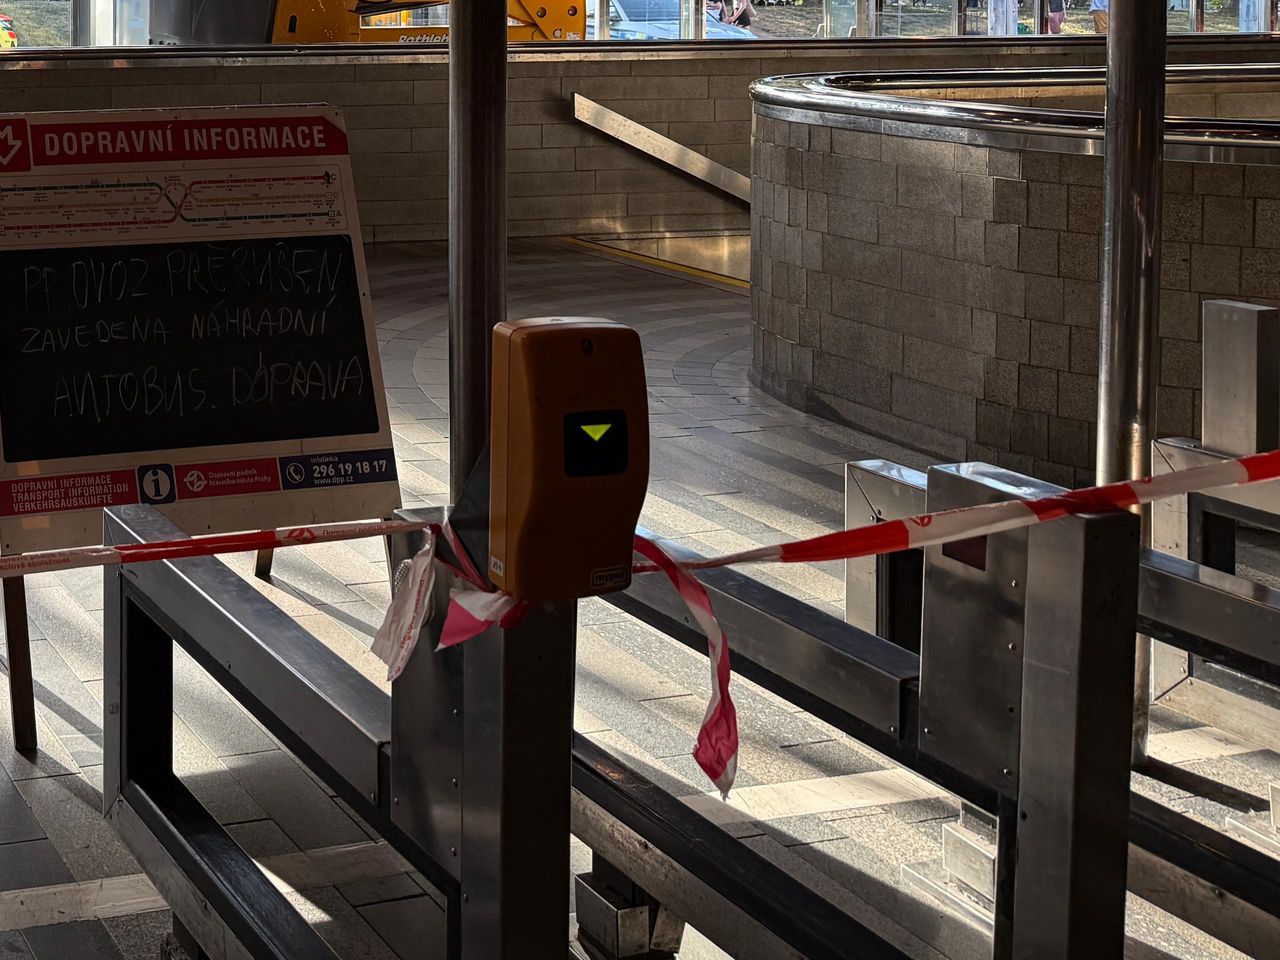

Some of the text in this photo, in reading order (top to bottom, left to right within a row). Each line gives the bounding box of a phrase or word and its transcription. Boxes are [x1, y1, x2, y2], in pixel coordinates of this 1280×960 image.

[44, 125, 328, 157] DOPRAVNÍ INFORMACE
[21, 294, 336, 353] ZAVEDENA NÁHRADNÍ
[310, 455, 339, 464] infolinka
[208, 468, 257, 480] Dopravní podnik
[313, 460, 388, 478] 296 19 18 17
[11, 475, 112, 493] DOPRAVNÍ INFORMACE
[209, 474, 271, 486] hlavního města Prahy
[313, 475, 354, 486] www.dpp.cz
[11, 482, 129, 503] TRANSPORT INFORMATION
